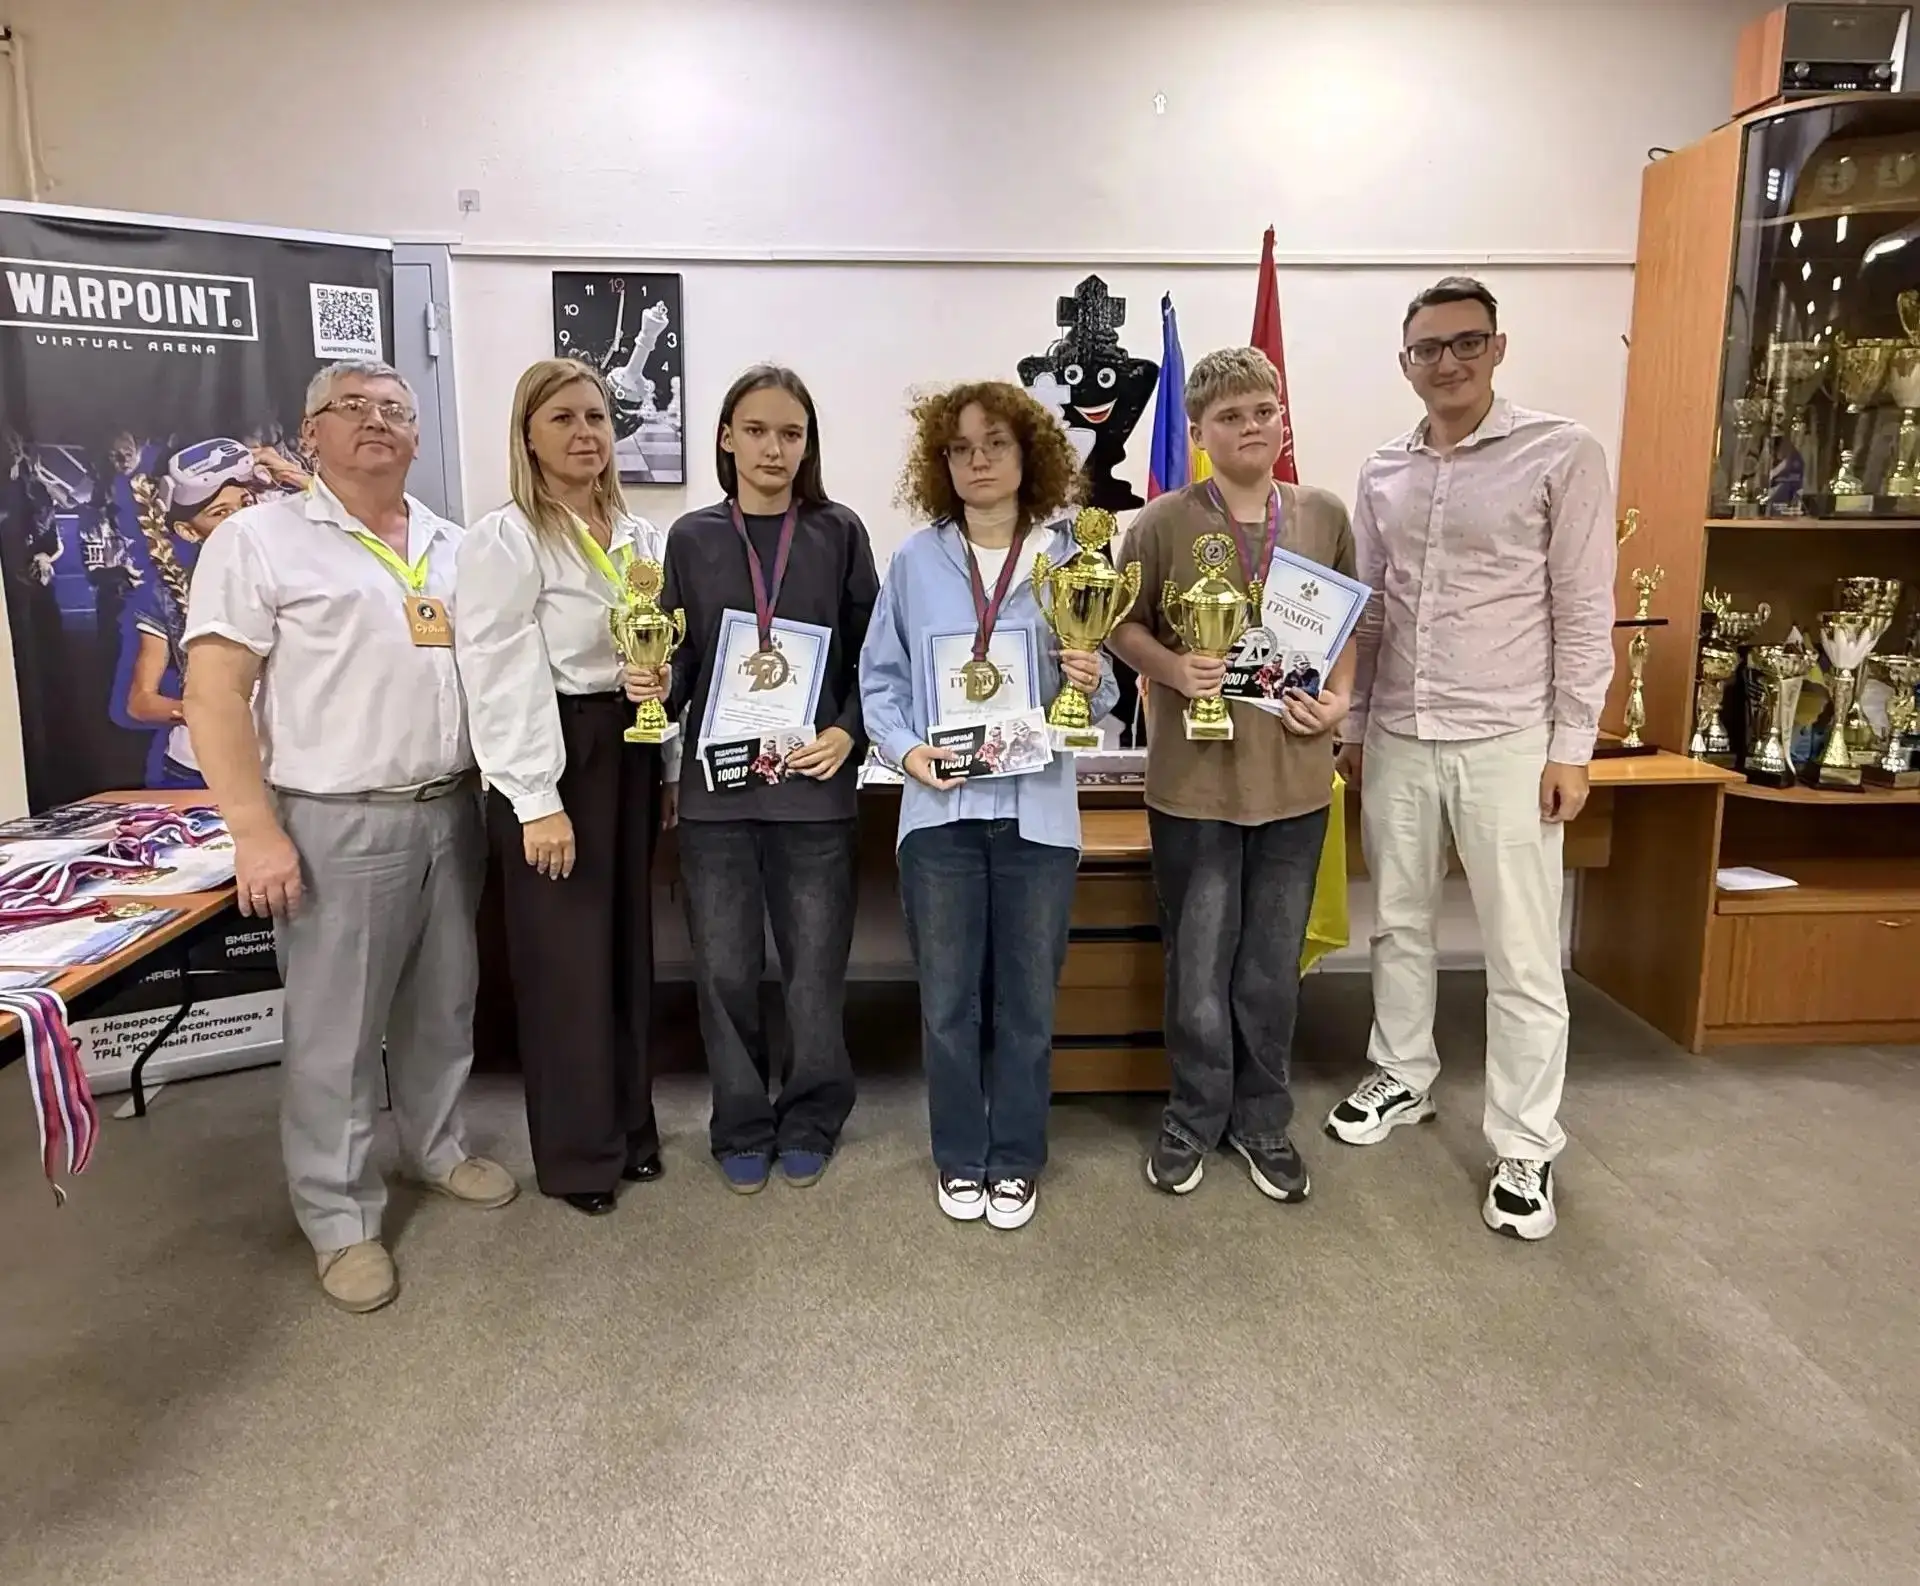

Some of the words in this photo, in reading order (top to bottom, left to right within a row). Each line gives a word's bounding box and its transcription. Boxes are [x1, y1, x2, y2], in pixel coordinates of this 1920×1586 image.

[585, 284, 595, 296] 11
[641, 286, 647, 296] 1
[5, 271, 231, 328] WARPOINT
[564, 304, 579, 316] 10
[559, 330, 570, 346] 9
[667, 332, 678, 348] 3
[148, 341, 217, 355] ARENA
[661, 361, 669, 371] 4
[614, 386, 626, 399] 6
[1209, 546, 1220, 559] 2
[1266, 600, 1323, 635] ГРАМОТА
[717, 766, 741, 782] 1000
[103, 1008, 210, 1032] Новороссск,
[92, 1038, 113, 1050] ул.
[117, 1028, 165, 1043] Герое
[264, 1007, 274, 1017] 2
[93, 1046, 121, 1060] ТРЦ
